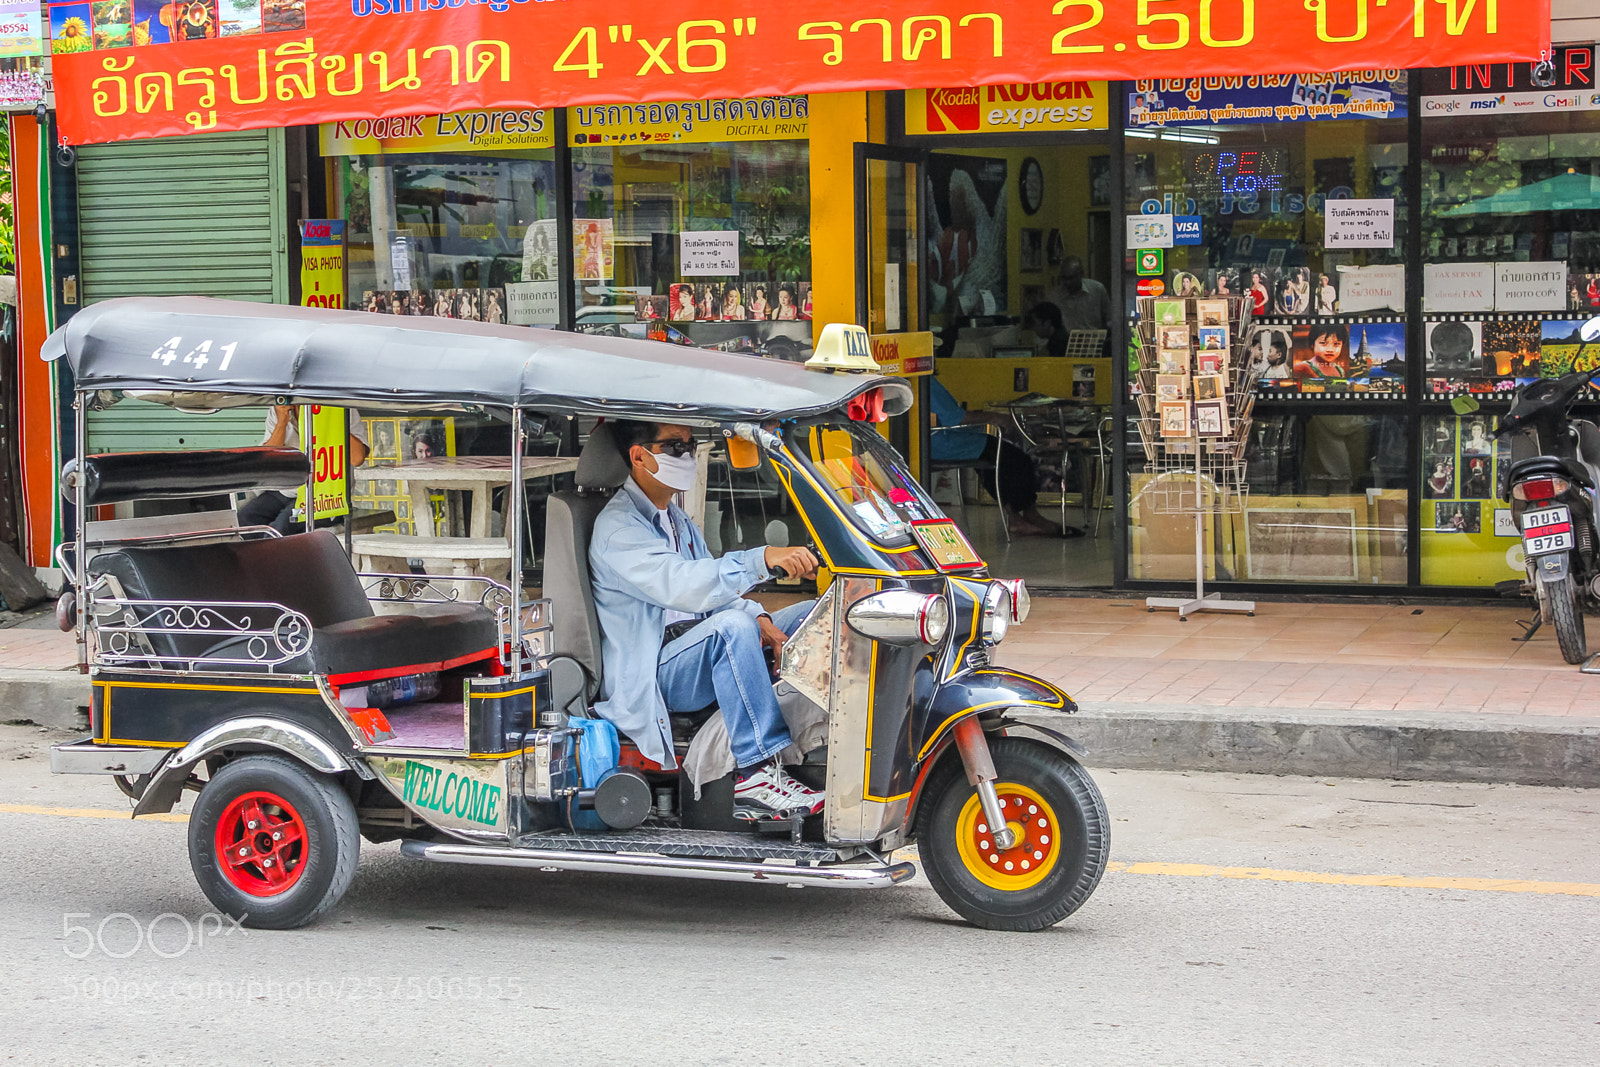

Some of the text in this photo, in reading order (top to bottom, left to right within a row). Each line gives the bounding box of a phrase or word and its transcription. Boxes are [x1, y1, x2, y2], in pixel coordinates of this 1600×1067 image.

[91, 0, 1497, 130] อัดรูปสีขนาด 4"x6" ราคา 2.50 บาท
[939, 91, 979, 106] Kodak
[1425, 100, 1461, 112] Google
[1470, 99, 1497, 109] msn
[987, 105, 1094, 129] express
[334, 110, 544, 142] Kodak Express
[726, 123, 808, 136] DIGITAL PRINT
[473, 134, 549, 147] Digital Solutions
[1195, 151, 1279, 175] OPEN
[304, 221, 332, 238] Kodak
[1175, 222, 1199, 232] VISA
[304, 256, 342, 270] VISA PHOTO
[1501, 268, 1561, 283] ถ่ายเอกสาร
[509, 287, 557, 301] ถ่ายเอกสาร
[1463, 289, 1483, 298] FAX
[1505, 291, 1533, 299] PHOTO
[514, 306, 555, 316] PHOTO COPY
[844, 331, 869, 356] TAXI
[873, 338, 899, 361] Kodak
[151, 336, 238, 371] 441
[881, 363, 900, 375] press
[1534, 535, 1564, 551] 978
[403, 760, 501, 827] WELCOME
